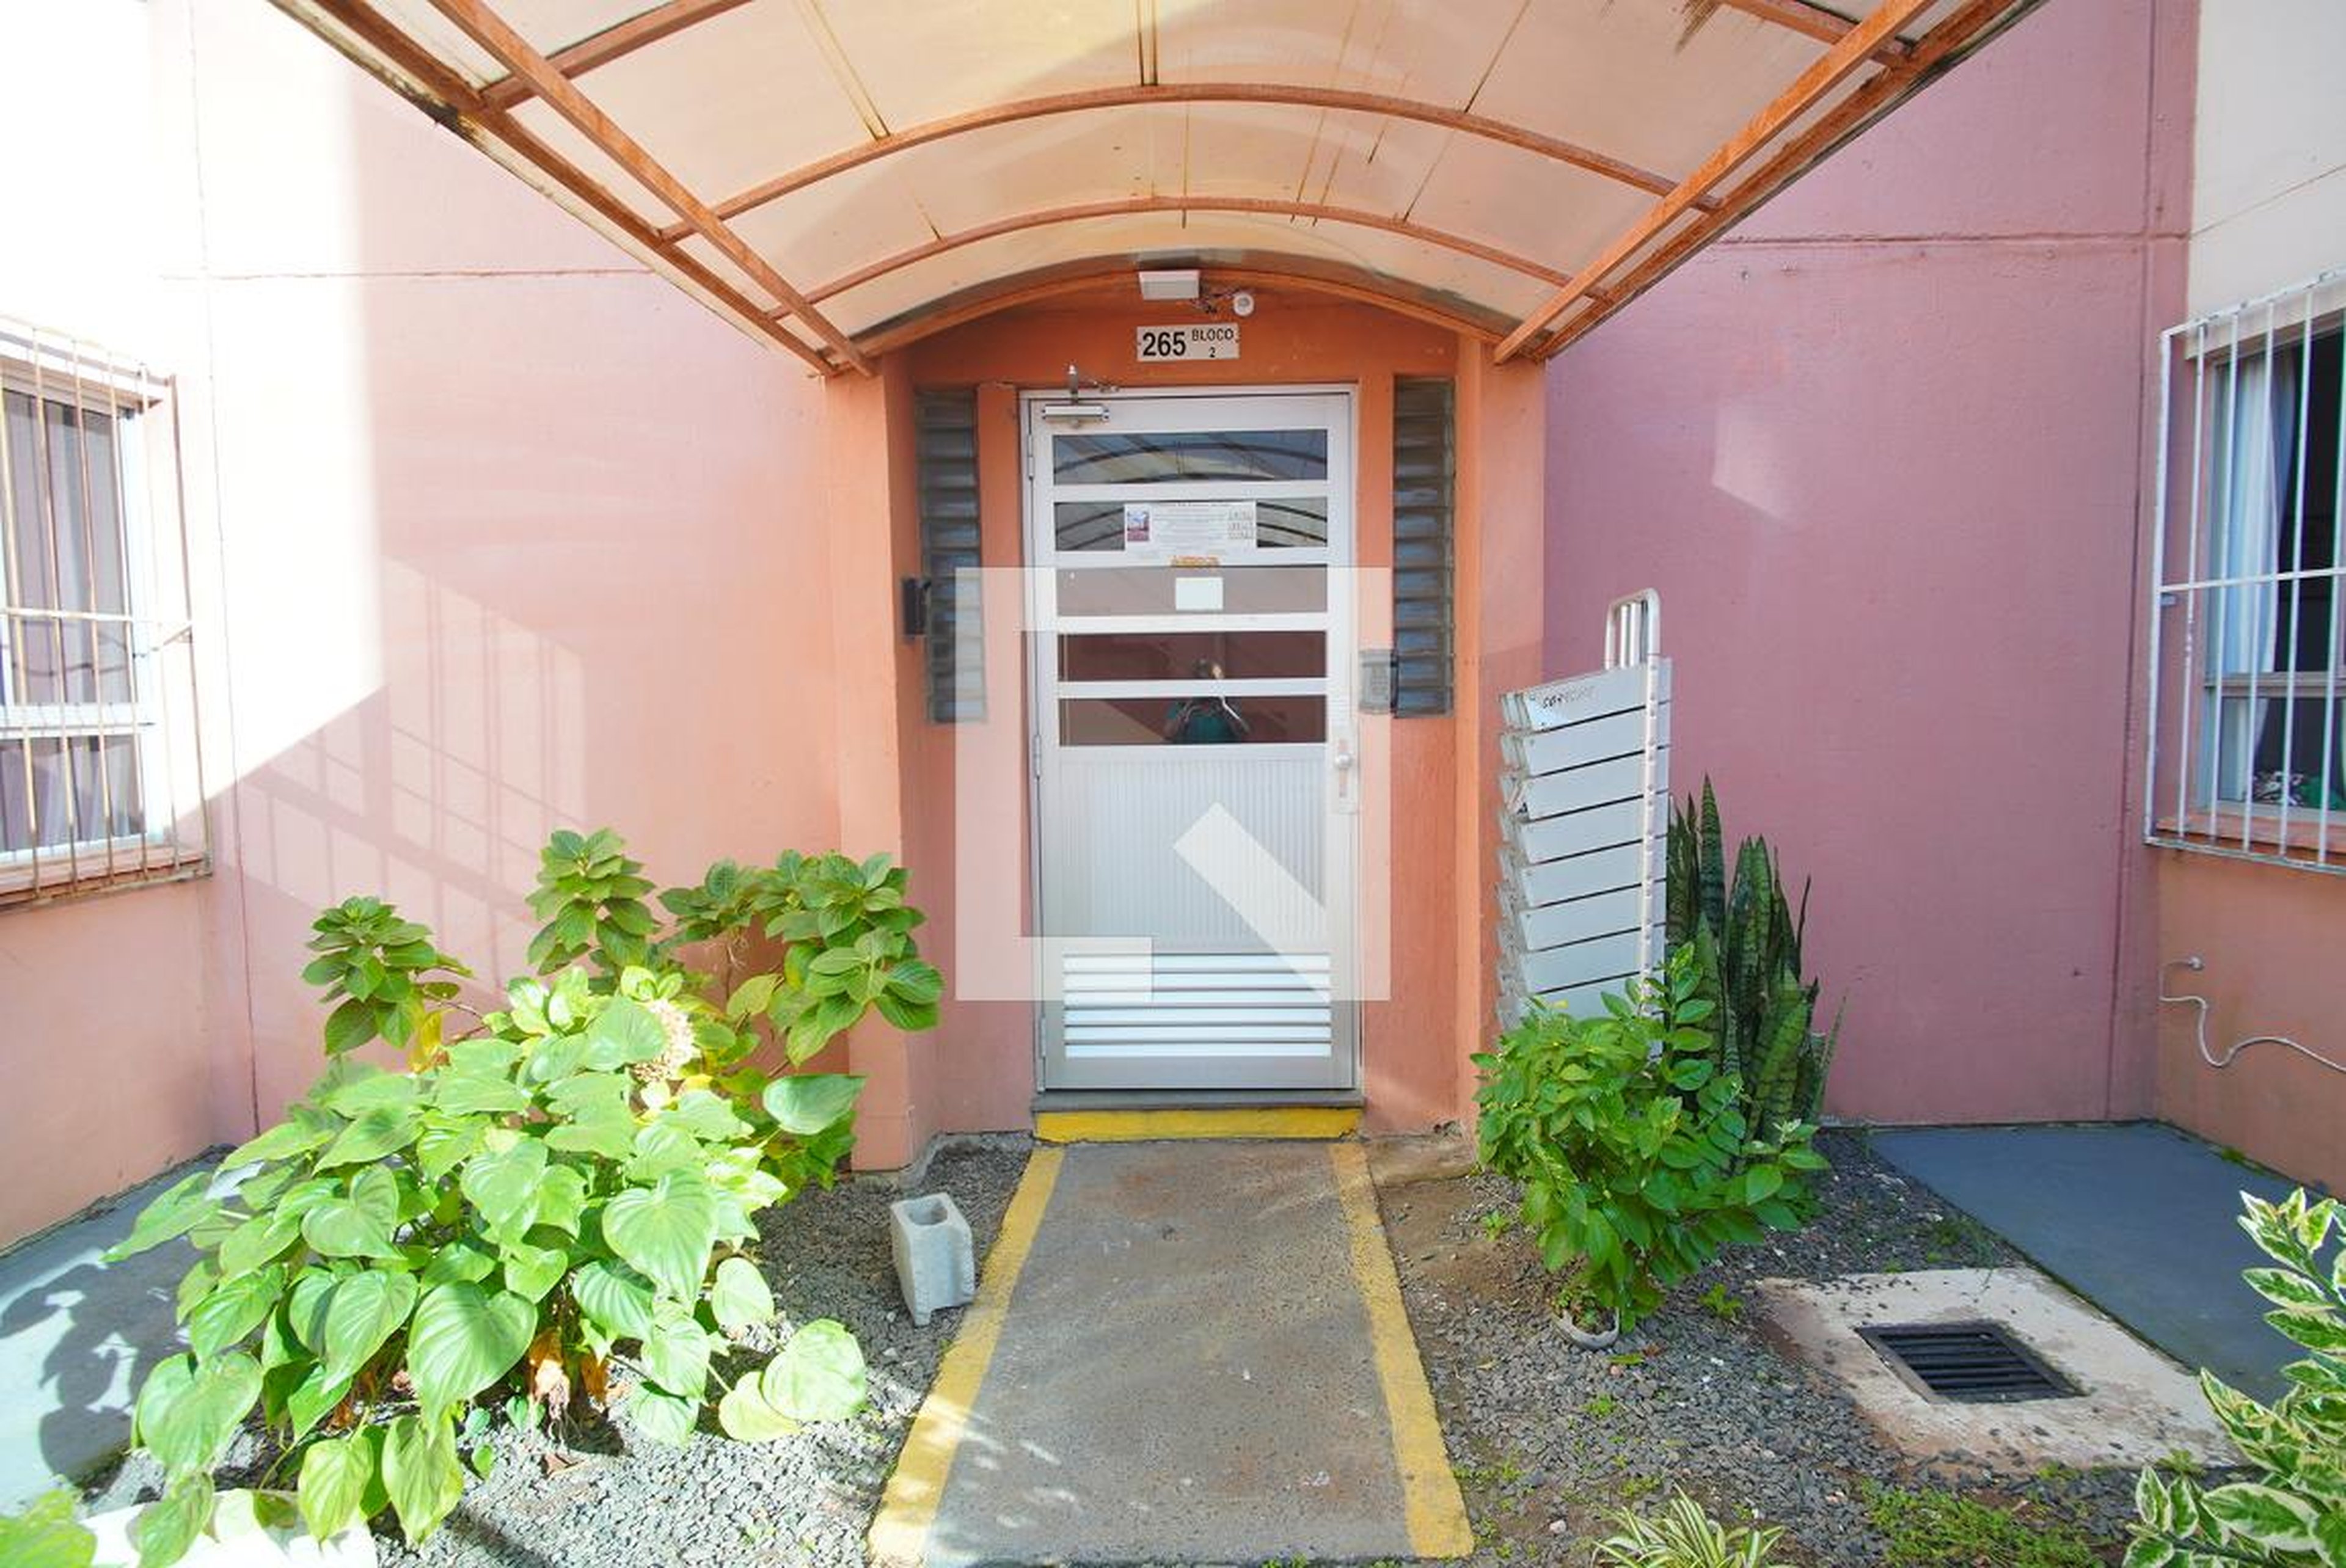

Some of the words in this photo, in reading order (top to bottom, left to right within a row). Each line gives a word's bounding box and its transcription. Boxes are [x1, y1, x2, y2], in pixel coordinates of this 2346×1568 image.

[1142, 332, 1186, 357] 265
[1191, 328, 1234, 341] BLOCO
[1208, 346, 1216, 358] 2
